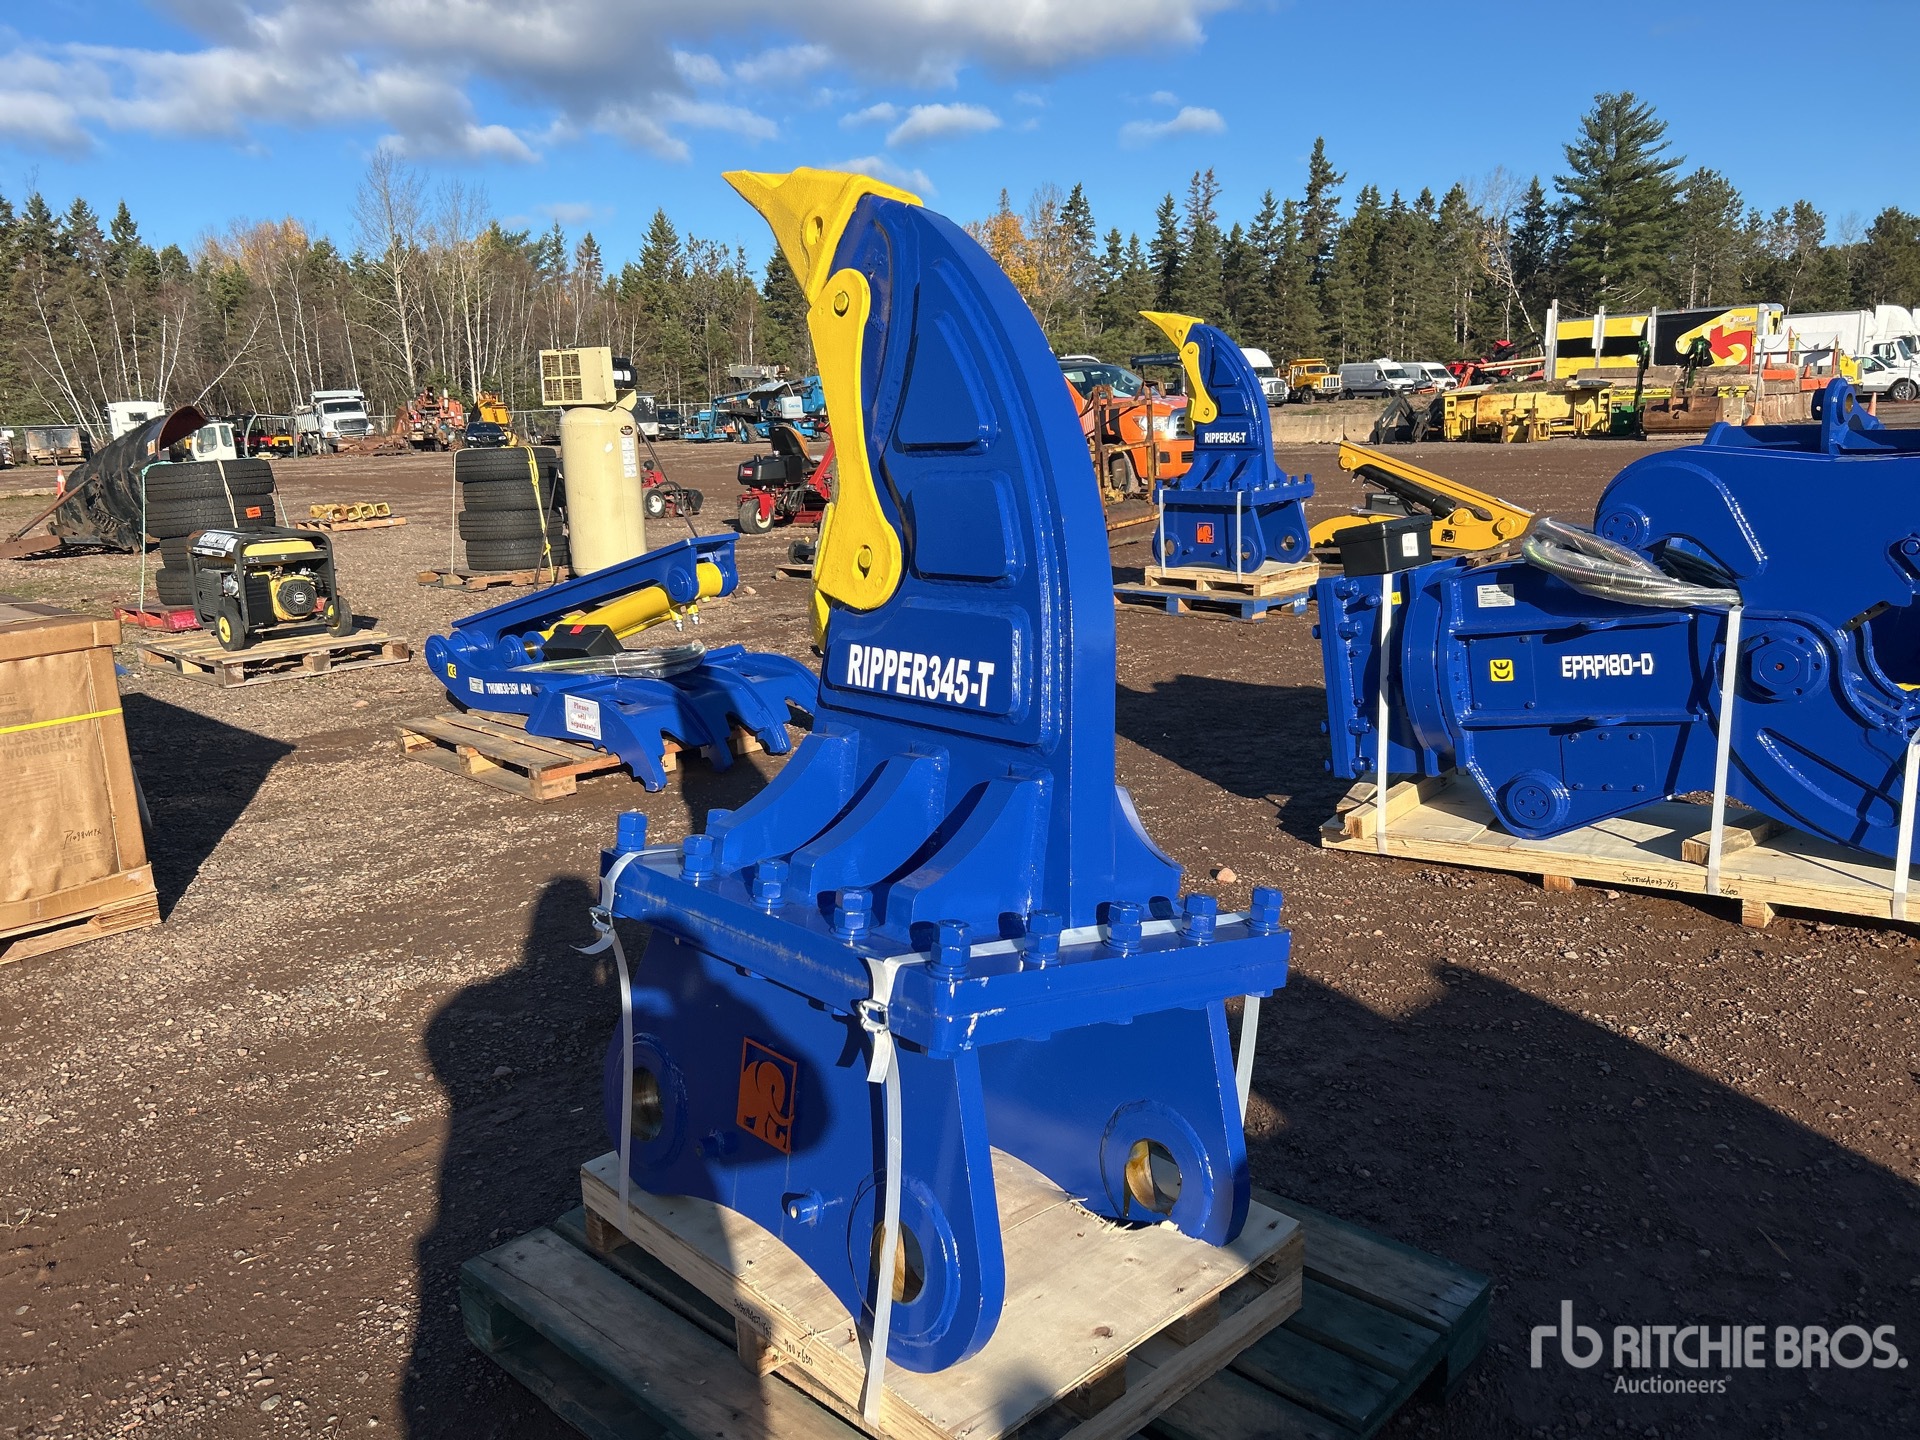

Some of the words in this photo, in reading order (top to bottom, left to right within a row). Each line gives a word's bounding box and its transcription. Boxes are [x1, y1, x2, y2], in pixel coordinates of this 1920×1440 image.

[1204, 432, 1247, 444] RIPPER345-T
[847, 643, 995, 707] RIPPER345-T
[1561, 653, 1654, 680] EPRP180-D
[573, 702, 589, 711] Please
[571, 721, 596, 732] separately
[3, 737, 82, 759] WORKBENCH
